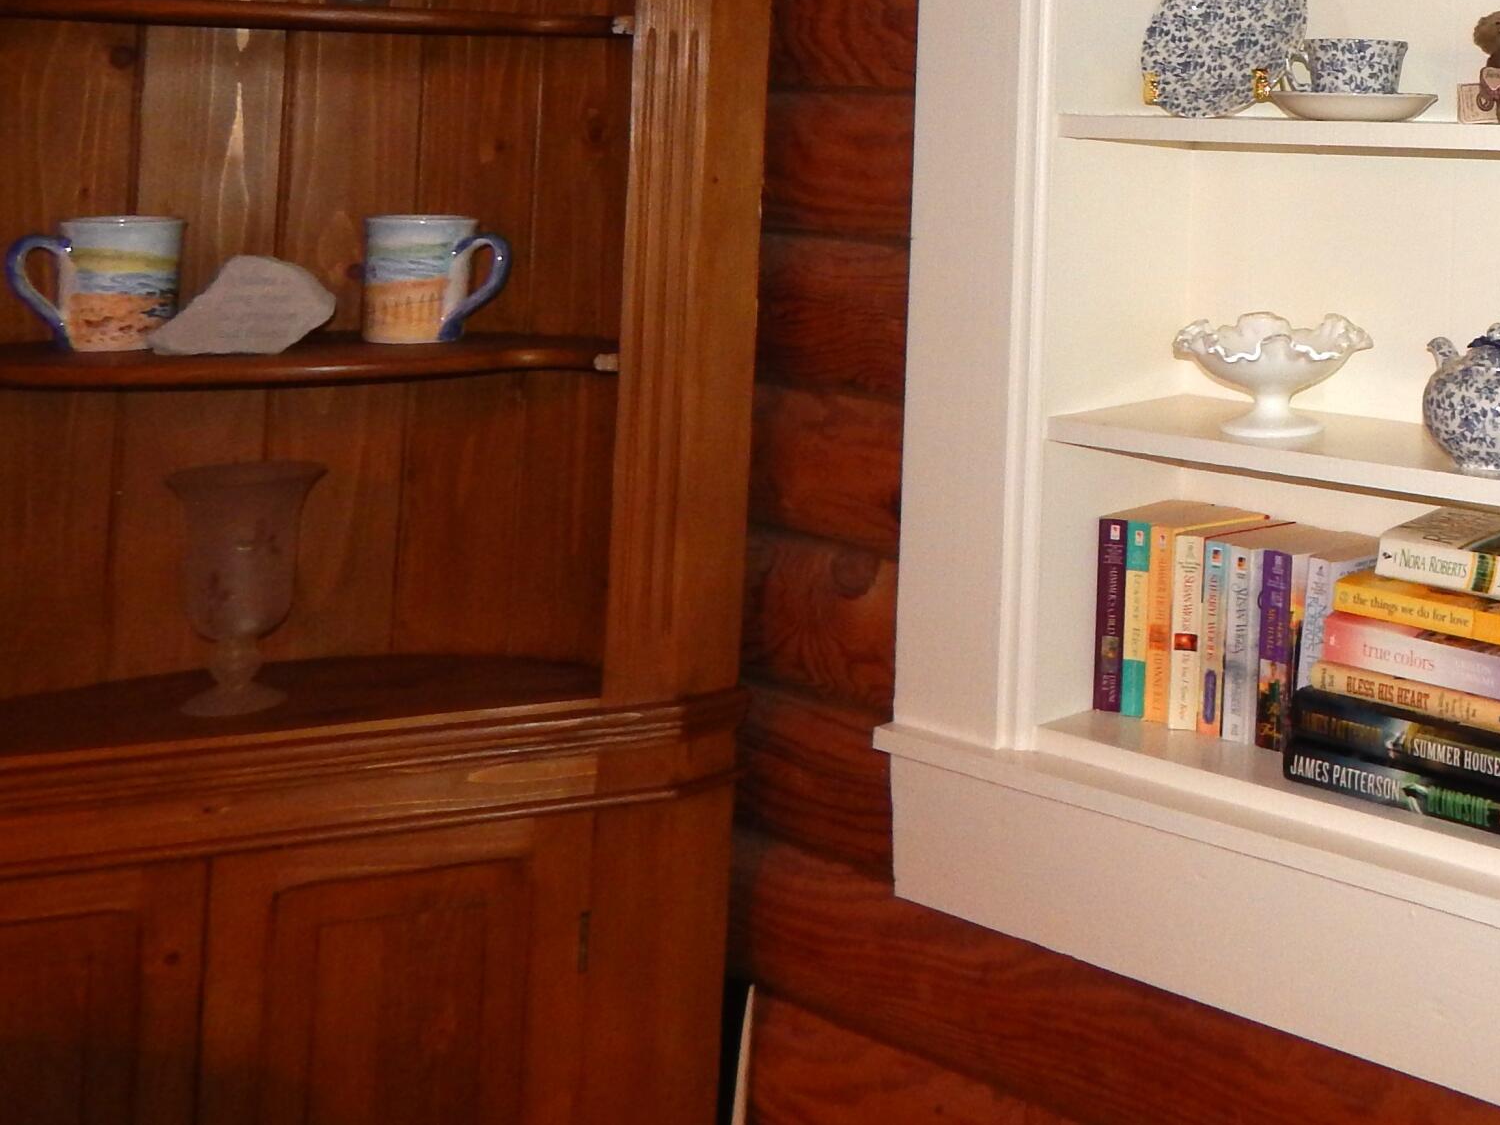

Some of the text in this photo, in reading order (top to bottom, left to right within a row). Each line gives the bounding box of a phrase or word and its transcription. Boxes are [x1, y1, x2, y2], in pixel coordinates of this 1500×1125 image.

[1400, 548, 1468, 578] NORA ROBERTS
[1184, 575, 1195, 603] SUSAN
[1231, 583, 1248, 620] SUSAN
[1183, 604, 1194, 633] WIGGS
[1304, 596, 1319, 652] ROBERTS
[1352, 593, 1469, 627] the things we do for love
[1207, 621, 1217, 661] WOODS
[1231, 623, 1247, 655] WIGGS
[1363, 642, 1391, 661] true
[1394, 650, 1435, 672] colors
[1346, 675, 1375, 696] BLESS
[1378, 683, 1394, 701] HIS
[1397, 686, 1430, 711] HEART
[1413, 738, 1500, 777] SUMMER HOUSE
[1290, 754, 1401, 801] JAMES PATTERSON
